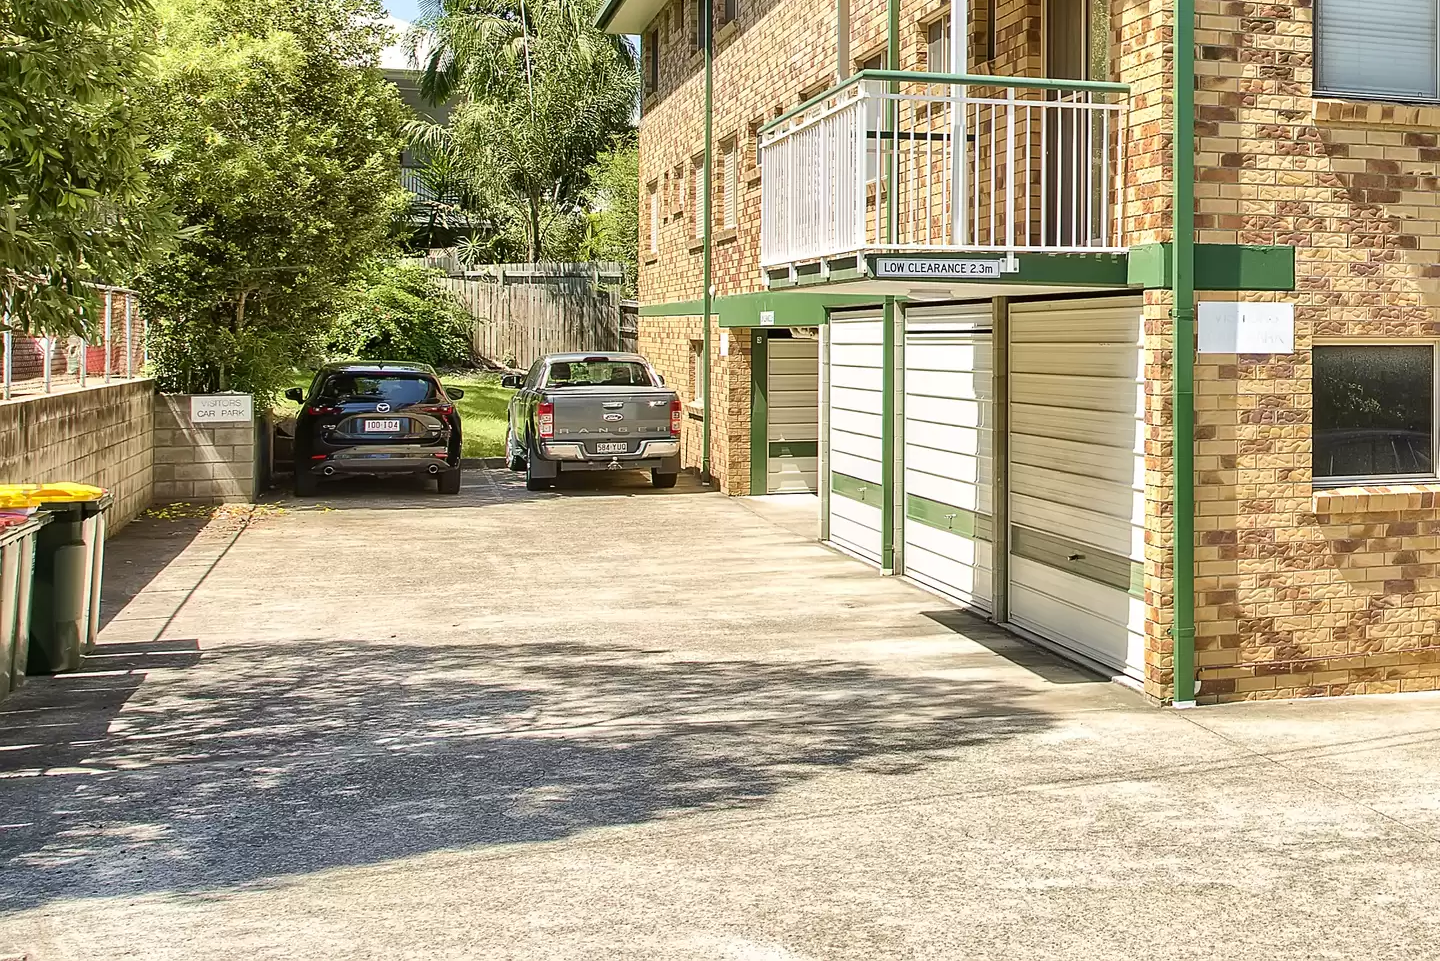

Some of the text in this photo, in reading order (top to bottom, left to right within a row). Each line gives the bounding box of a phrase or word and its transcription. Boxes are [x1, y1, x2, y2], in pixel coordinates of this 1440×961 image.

[884, 262, 993, 274] LOW CLEARANCE 2.3m
[200, 399, 242, 408] VISITORS
[196, 409, 245, 418] CAR PARK
